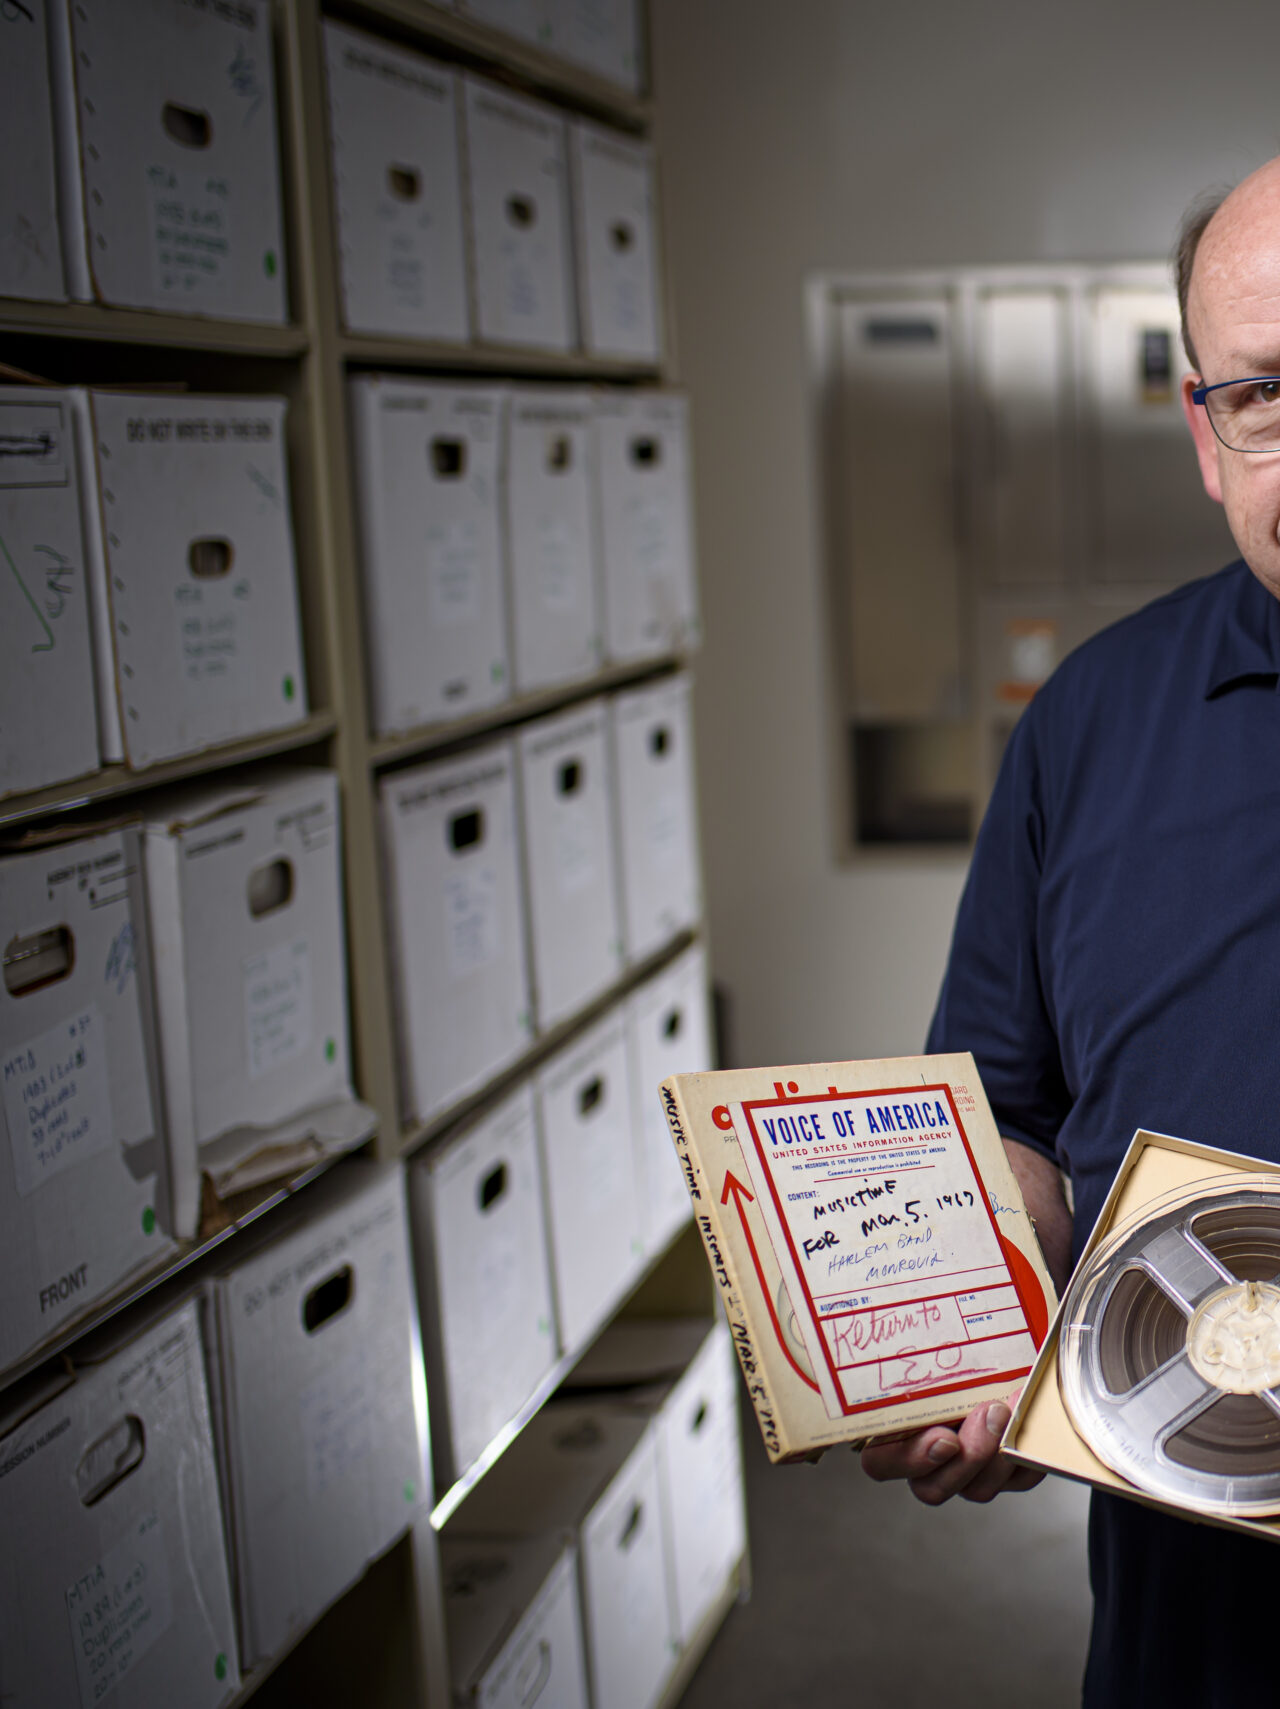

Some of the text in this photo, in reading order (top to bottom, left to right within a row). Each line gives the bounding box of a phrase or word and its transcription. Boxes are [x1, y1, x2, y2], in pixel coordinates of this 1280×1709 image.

[662, 1086, 688, 1146] MUSIC
[763, 1114, 825, 1146] VOICE
[832, 1110, 856, 1138] OF
[865, 1101, 949, 1134] AMERICA
[773, 1131, 952, 1159] UNITED STATES INFORMATION AGENCY
[805, 1162, 829, 1170] RECORDING
[848, 1156, 869, 1164] PROPERTY
[827, 1168, 853, 1176] Commercial
[868, 1163, 895, 1172] reproduction
[900, 1160, 921, 1169] prohibited
[788, 1190, 820, 1201] CONTENT:
[828, 1227, 933, 1276] HARLEM BAND
[38, 1262, 89, 1315] FRONT
[820, 1295, 873, 1312] AUDITIONED BY:
